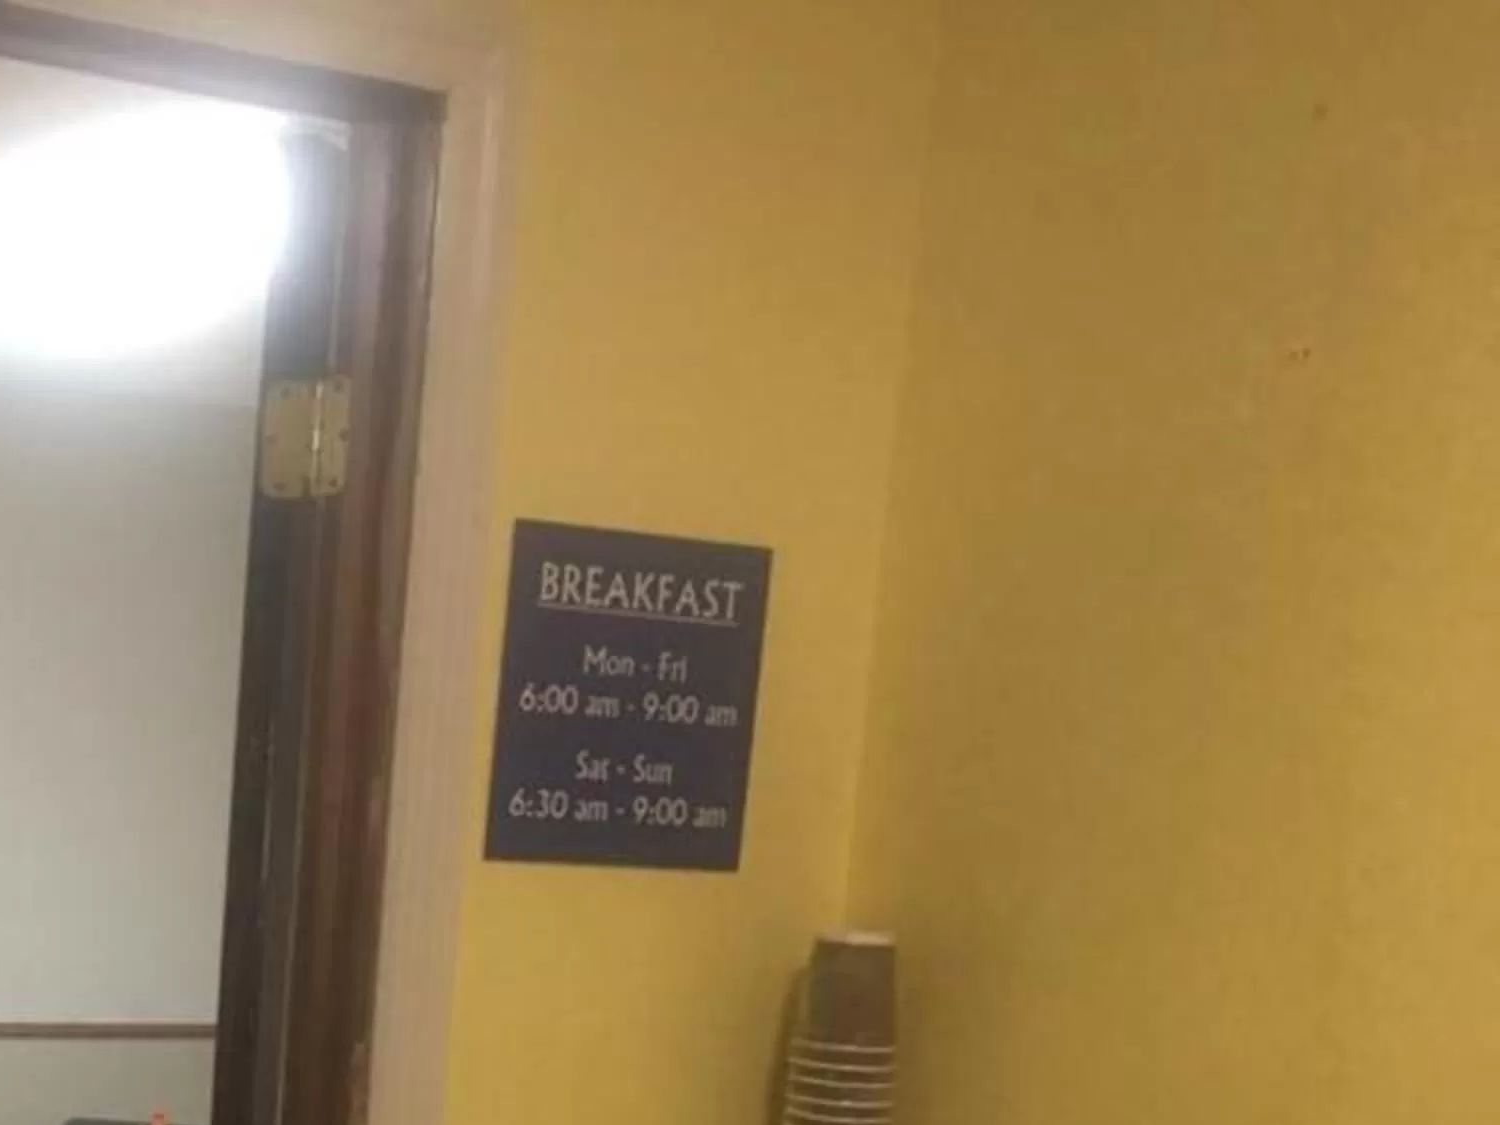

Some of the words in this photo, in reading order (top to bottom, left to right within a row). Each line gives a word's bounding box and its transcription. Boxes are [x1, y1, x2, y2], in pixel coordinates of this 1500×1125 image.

[540, 561, 744, 622] BREAKFAST
[582, 645, 636, 677] Mon
[657, 652, 688, 684] Fri
[518, 684, 580, 715] 6:00
[584, 696, 621, 718] am
[643, 691, 700, 724] 9:00
[704, 705, 739, 727] am
[575, 750, 611, 782] Sat
[632, 753, 674, 785] Sun
[508, 788, 569, 819] 6:30
[574, 800, 610, 822] am
[632, 796, 688, 826] 9:00
[692, 807, 727, 828] am
